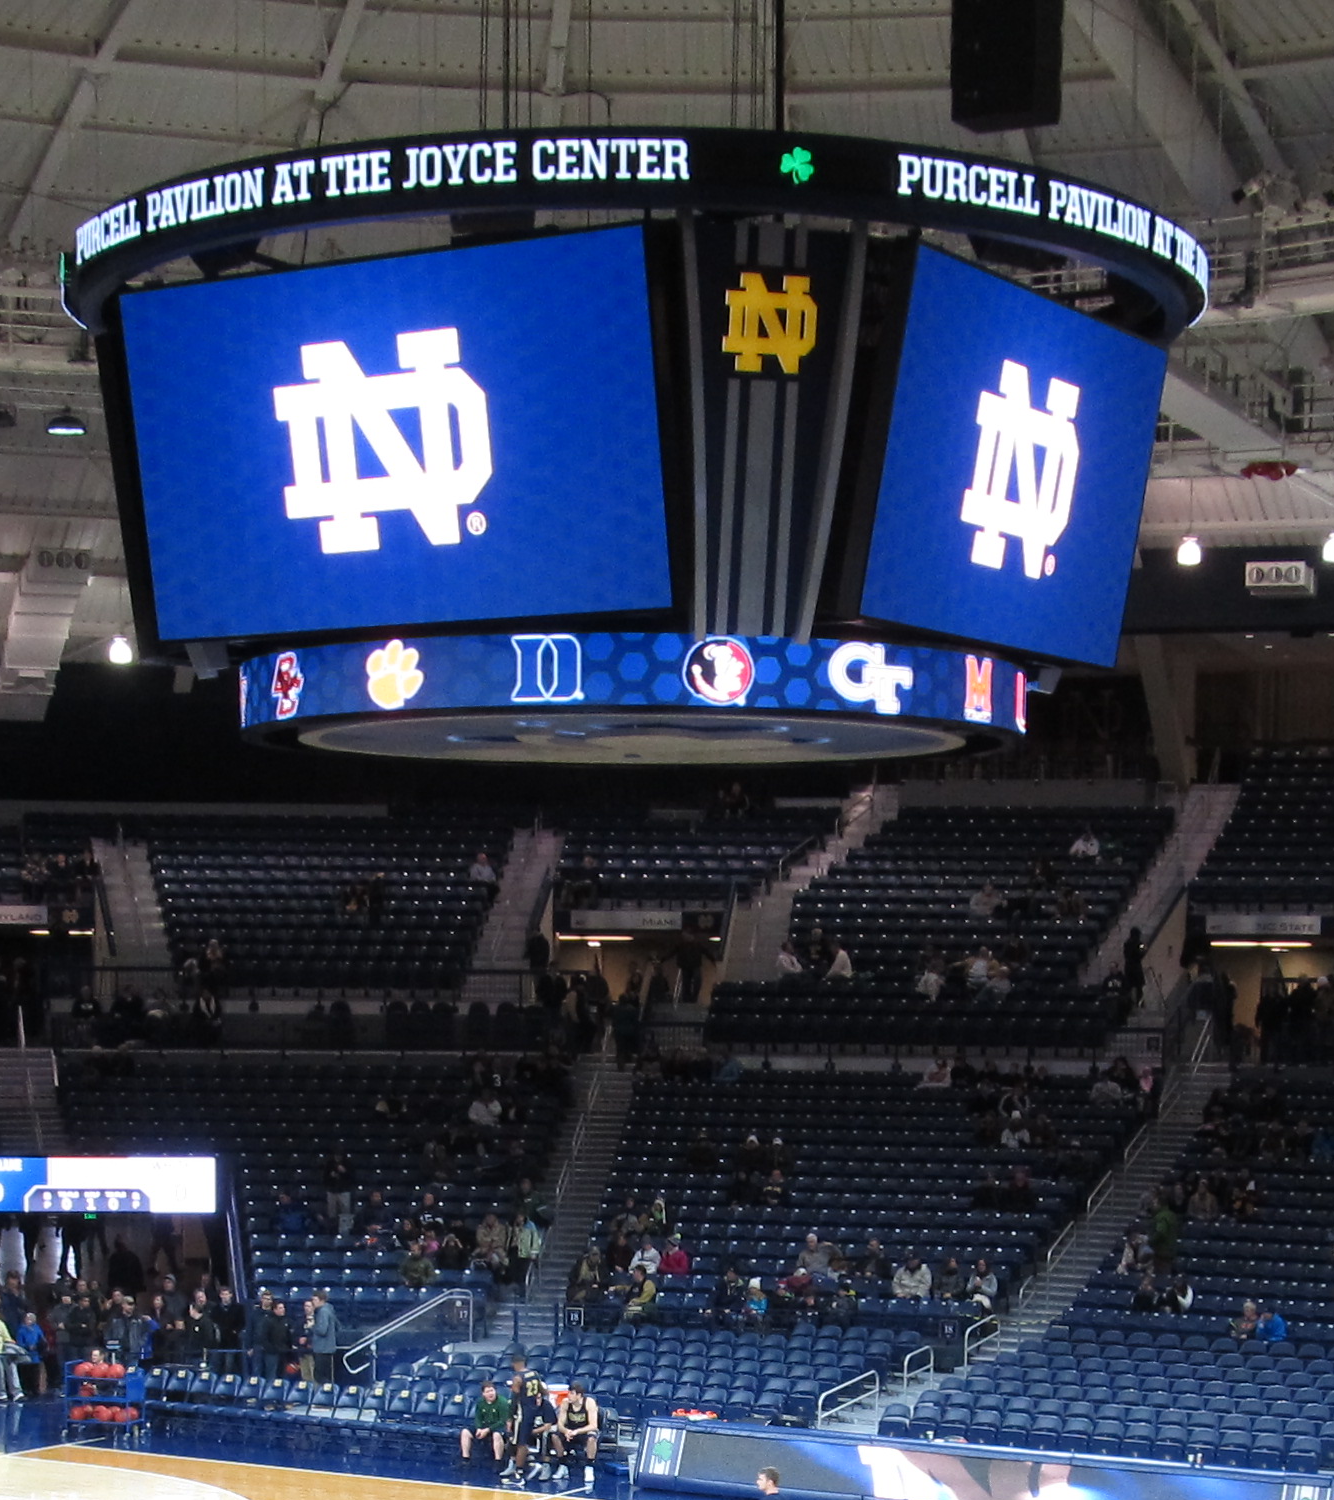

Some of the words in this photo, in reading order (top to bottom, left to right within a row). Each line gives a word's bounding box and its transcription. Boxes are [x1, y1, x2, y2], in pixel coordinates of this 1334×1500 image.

[75, 200, 140, 266] PURCELL
[146, 167, 265, 234] PAVILION
[271, 161, 315, 206] AT
[321, 150, 392, 199] THE
[402, 140, 517, 189] JOYCE
[531, 138, 690, 181] CENTER
[897, 153, 1041, 217] PURCELL
[1047, 179, 1151, 249] PAVILION
[1152, 214, 1175, 260] AT
[492, 1073, 502, 1088] 3
[525, 1379, 540, 1398] 23
